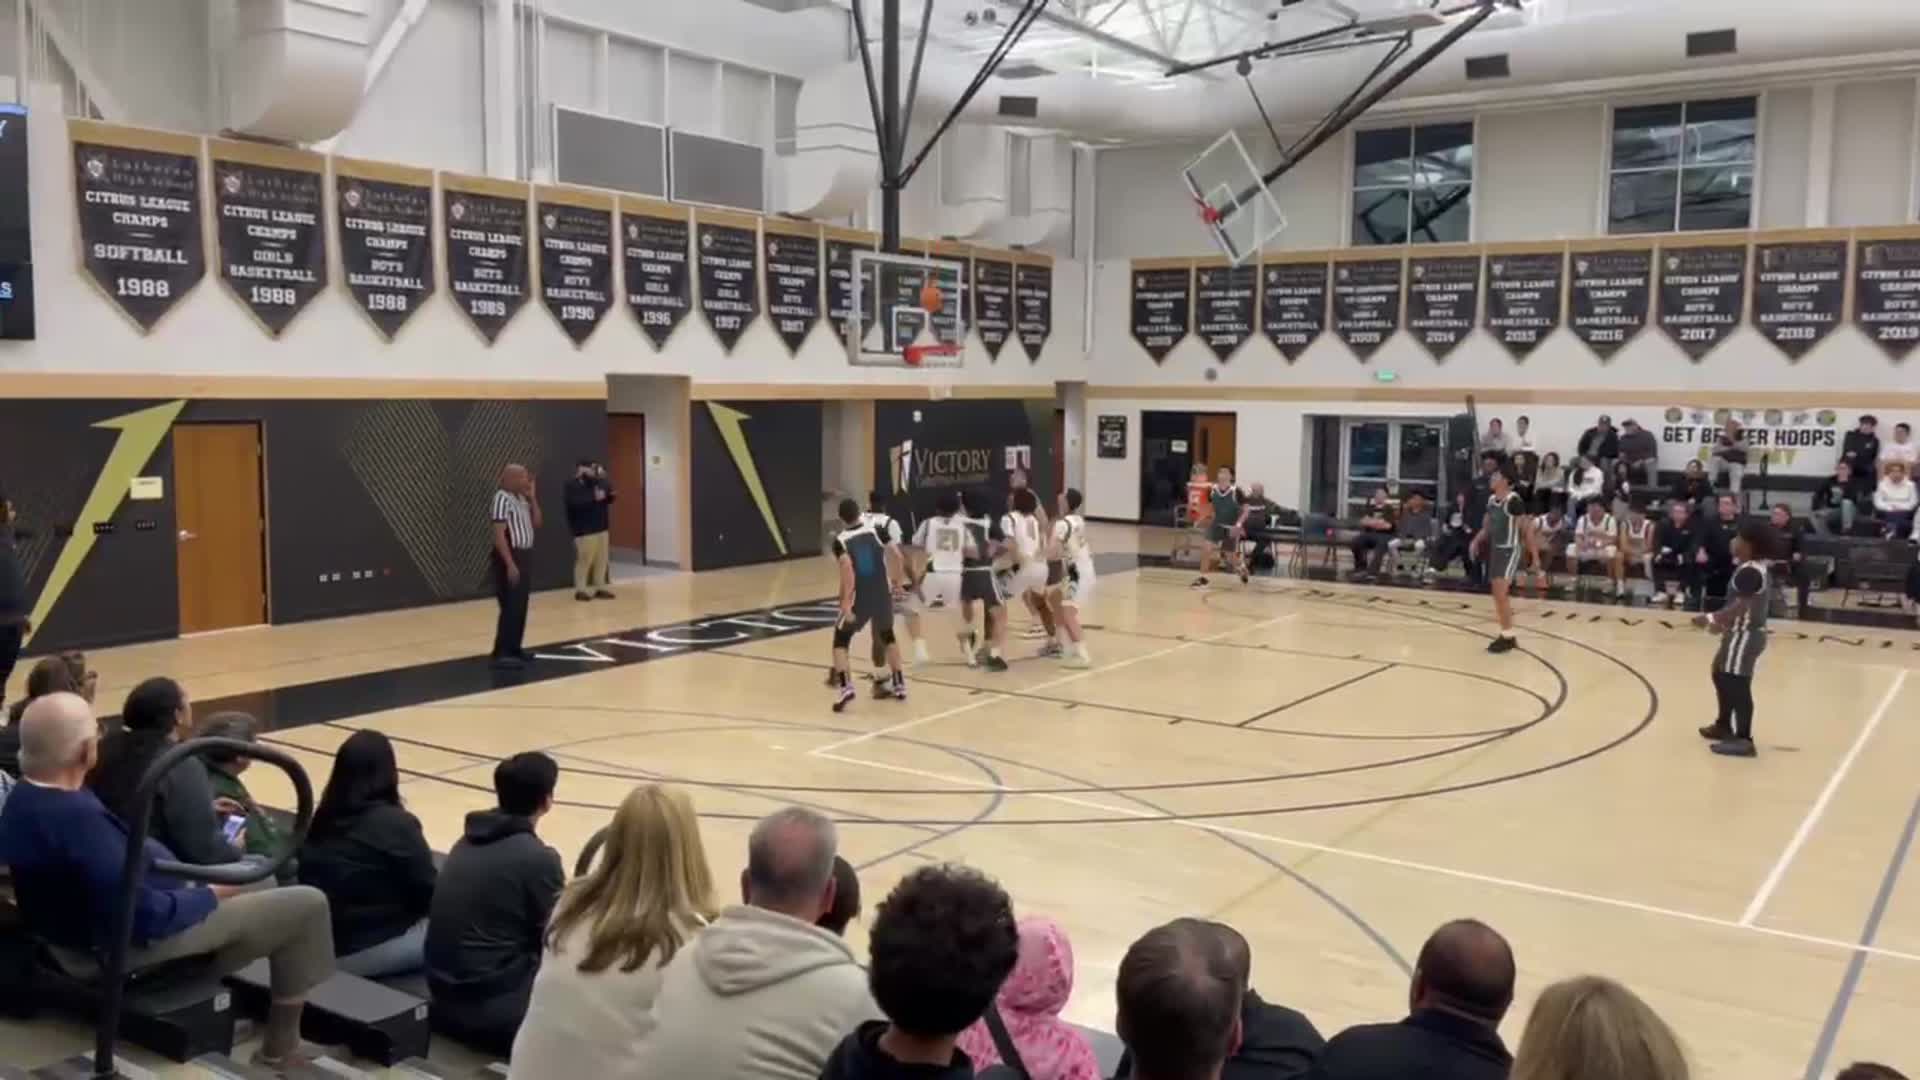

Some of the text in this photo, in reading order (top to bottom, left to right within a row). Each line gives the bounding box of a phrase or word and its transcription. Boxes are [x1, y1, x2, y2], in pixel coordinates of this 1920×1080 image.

[85, 191, 191, 212] CITRUS LEAGUE
[112, 211, 168, 228] CHAMPS
[223, 204, 316, 225] CITRUS LEAGUE
[246, 224, 297, 240] CHAMPS
[345, 216, 426, 237] CITRUS LEAGUE
[365, 236, 408, 250] CHAMPS
[450, 228, 522, 246] CITRUS LEAGUE
[93, 243, 189, 264] SOFTBALL
[253, 250, 294, 264] GIRLS
[468, 246, 507, 259] CHAMPS
[230, 264, 316, 282] BASKETBALL
[371, 259, 403, 273] BOYS
[350, 272, 424, 289] BASKETBALL
[1701, 273, 1740, 284] LEAGUE
[1799, 270, 1840, 282] LEAGUE
[1903, 268, 1920, 280] LEA
[117, 277, 170, 297] 1988
[250, 284, 296, 305] 1988
[454, 281, 522, 296] BASKETBALL
[1681, 286, 1721, 297] CHAMPS
[1777, 284, 1820, 295] CHAMPS
[1879, 281, 1920, 293] CHAMP
[368, 293, 407, 311] 1988
[546, 288, 606, 302] BASKETBALL
[561, 305, 595, 320] 1990
[643, 311, 672, 326] 1996
[1663, 313, 1733, 325] BASKETBALL
[1760, 312, 1834, 323] BASKETBALL
[1589, 328, 1624, 342] 2016
[1680, 327, 1717, 341] 2017
[1776, 326, 1817, 341] 2018
[1663, 426, 1836, 447] GET BEER HOOPS
[914, 448, 992, 475] VICTORY
[935, 528, 960, 551] 21
[532, 602, 843, 663] VICTO
